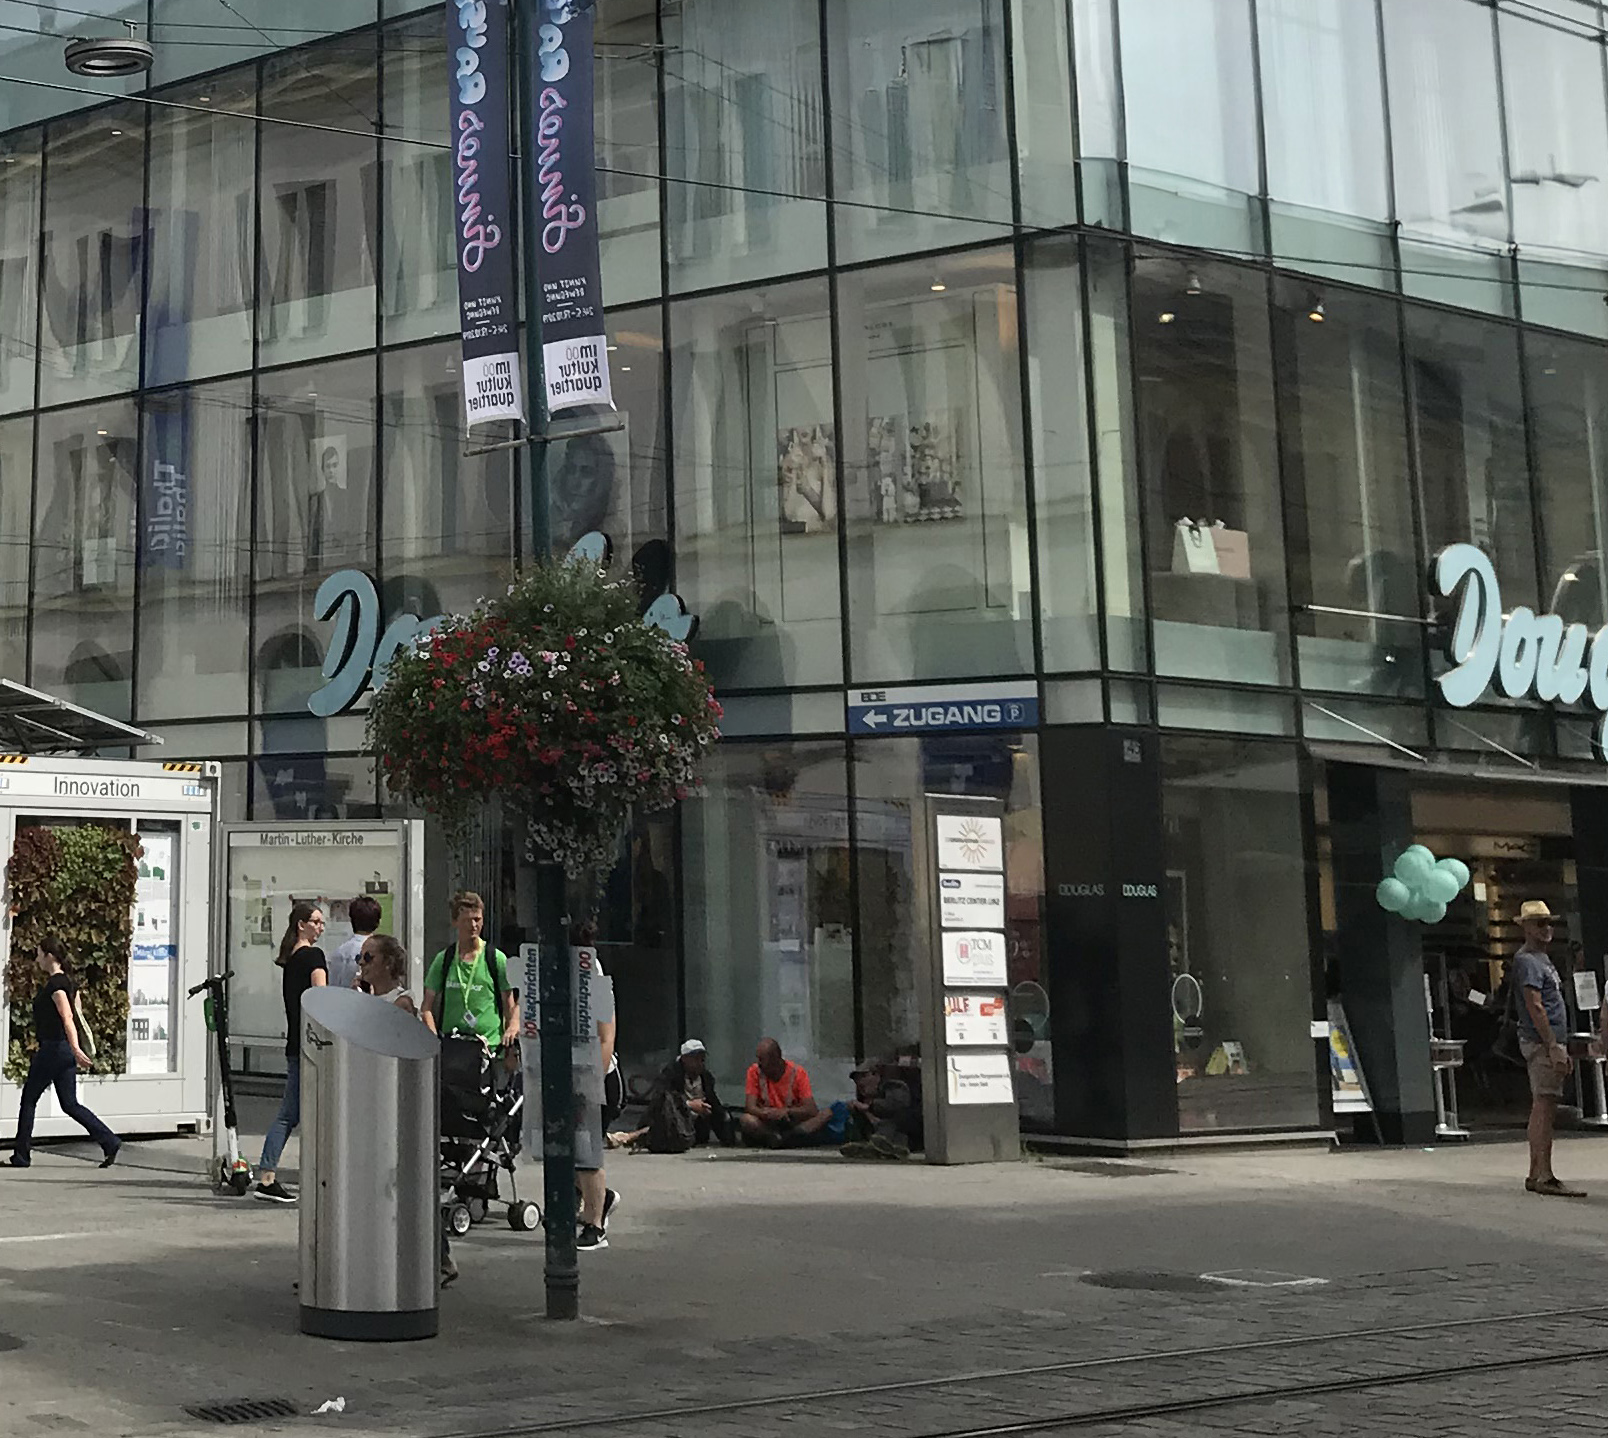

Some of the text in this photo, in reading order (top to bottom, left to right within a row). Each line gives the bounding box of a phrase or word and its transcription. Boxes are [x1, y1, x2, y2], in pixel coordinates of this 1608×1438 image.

[893, 704, 1001, 728] ZUGANG
[53, 776, 141, 798] Innovation
[1058, 883, 1105, 897] DOUGLAS
[1122, 883, 1159, 897] DOUGLAS
[971, 938, 993, 952] TCM
